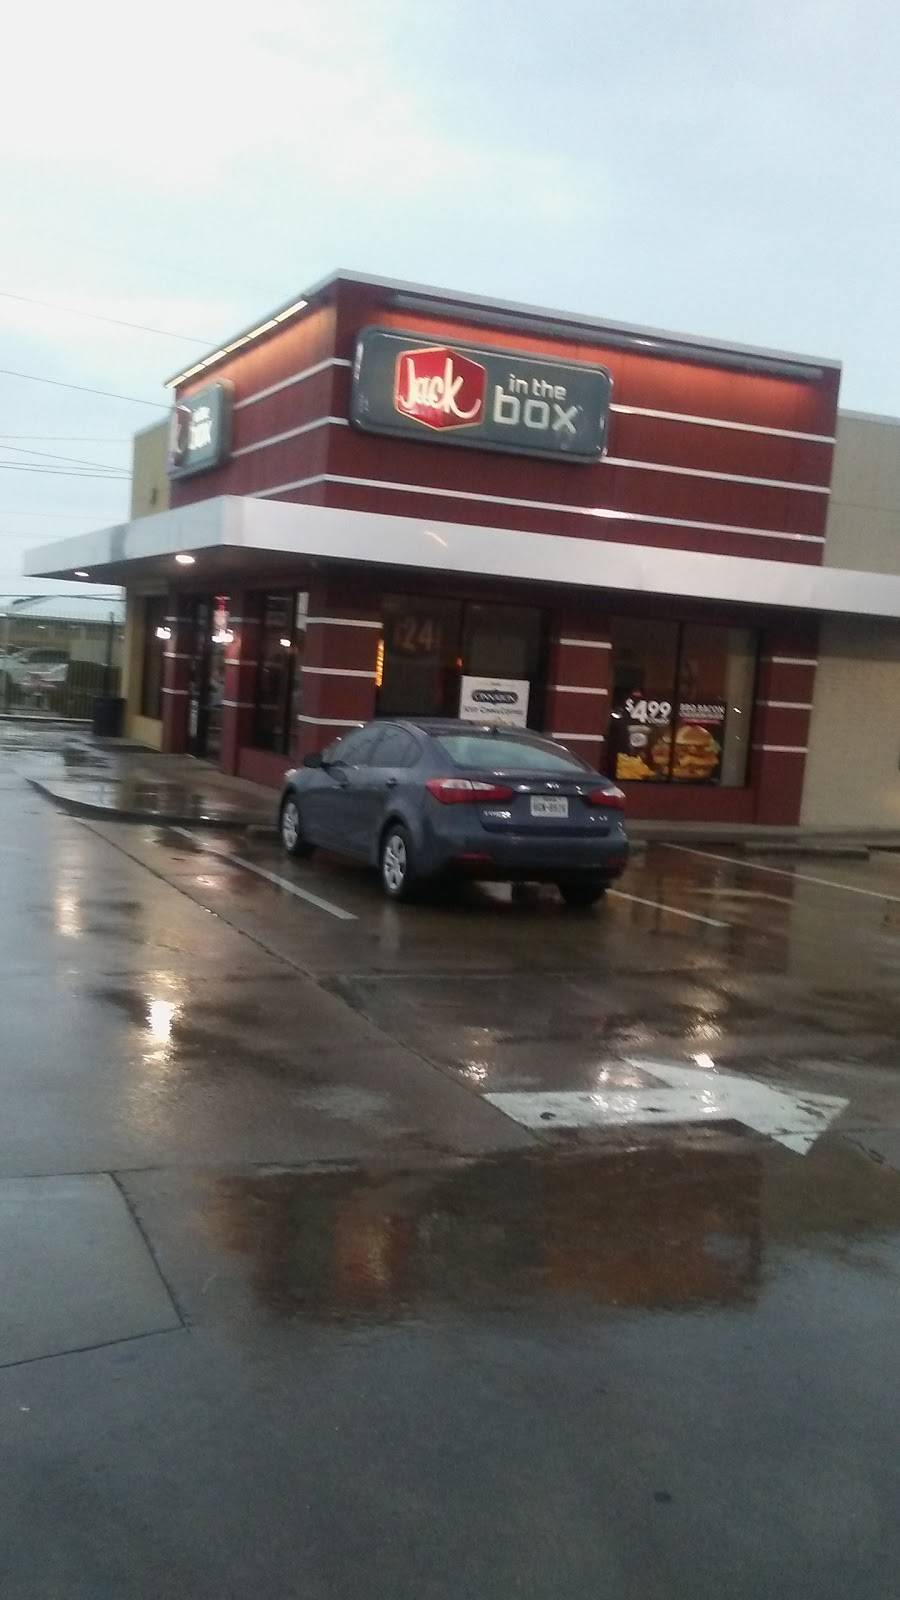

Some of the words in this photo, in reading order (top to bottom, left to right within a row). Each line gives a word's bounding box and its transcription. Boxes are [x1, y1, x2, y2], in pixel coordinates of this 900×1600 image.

[397, 357, 481, 420] Jack
[493, 384, 578, 434] box
[509, 373, 529, 394] in
[532, 378, 567, 401] the
